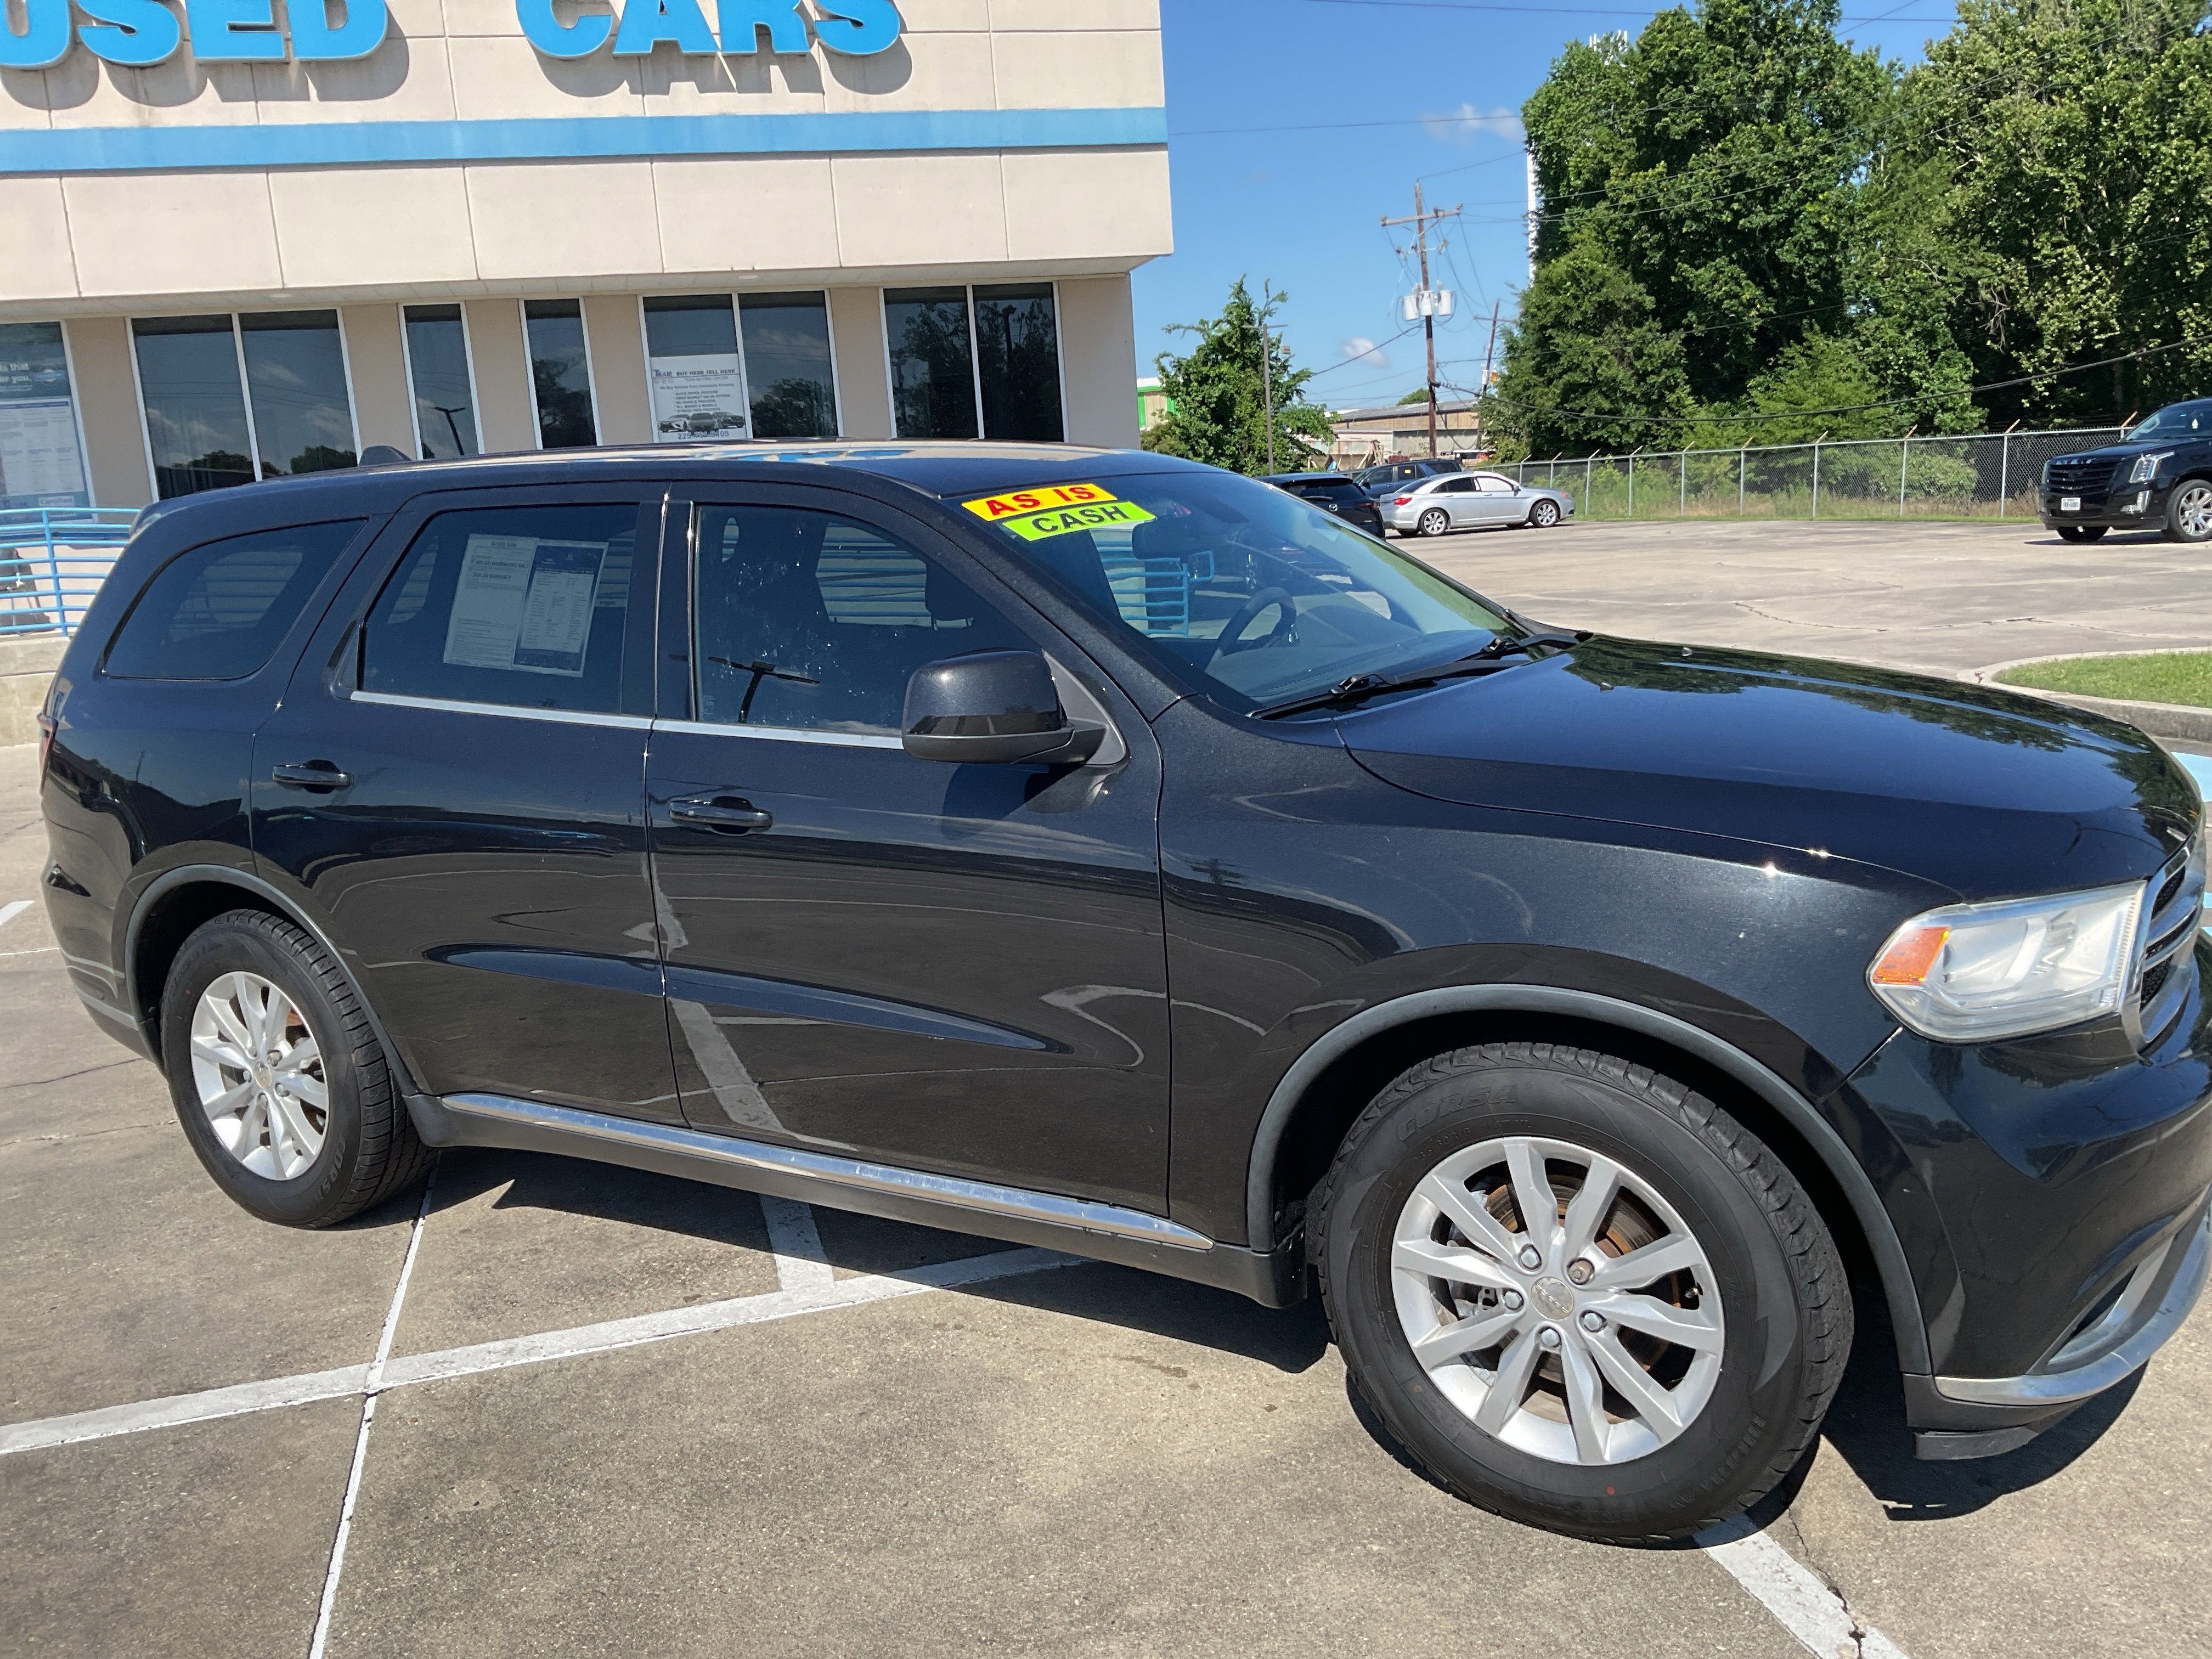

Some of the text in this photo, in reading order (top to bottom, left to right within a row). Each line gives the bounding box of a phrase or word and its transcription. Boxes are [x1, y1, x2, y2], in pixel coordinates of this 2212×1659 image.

[517, 0, 900, 58] CARS
[985, 486, 1097, 516] AS IS
[1031, 505, 1131, 533] CASH
[1396, 1084, 1519, 1142] CORSA
